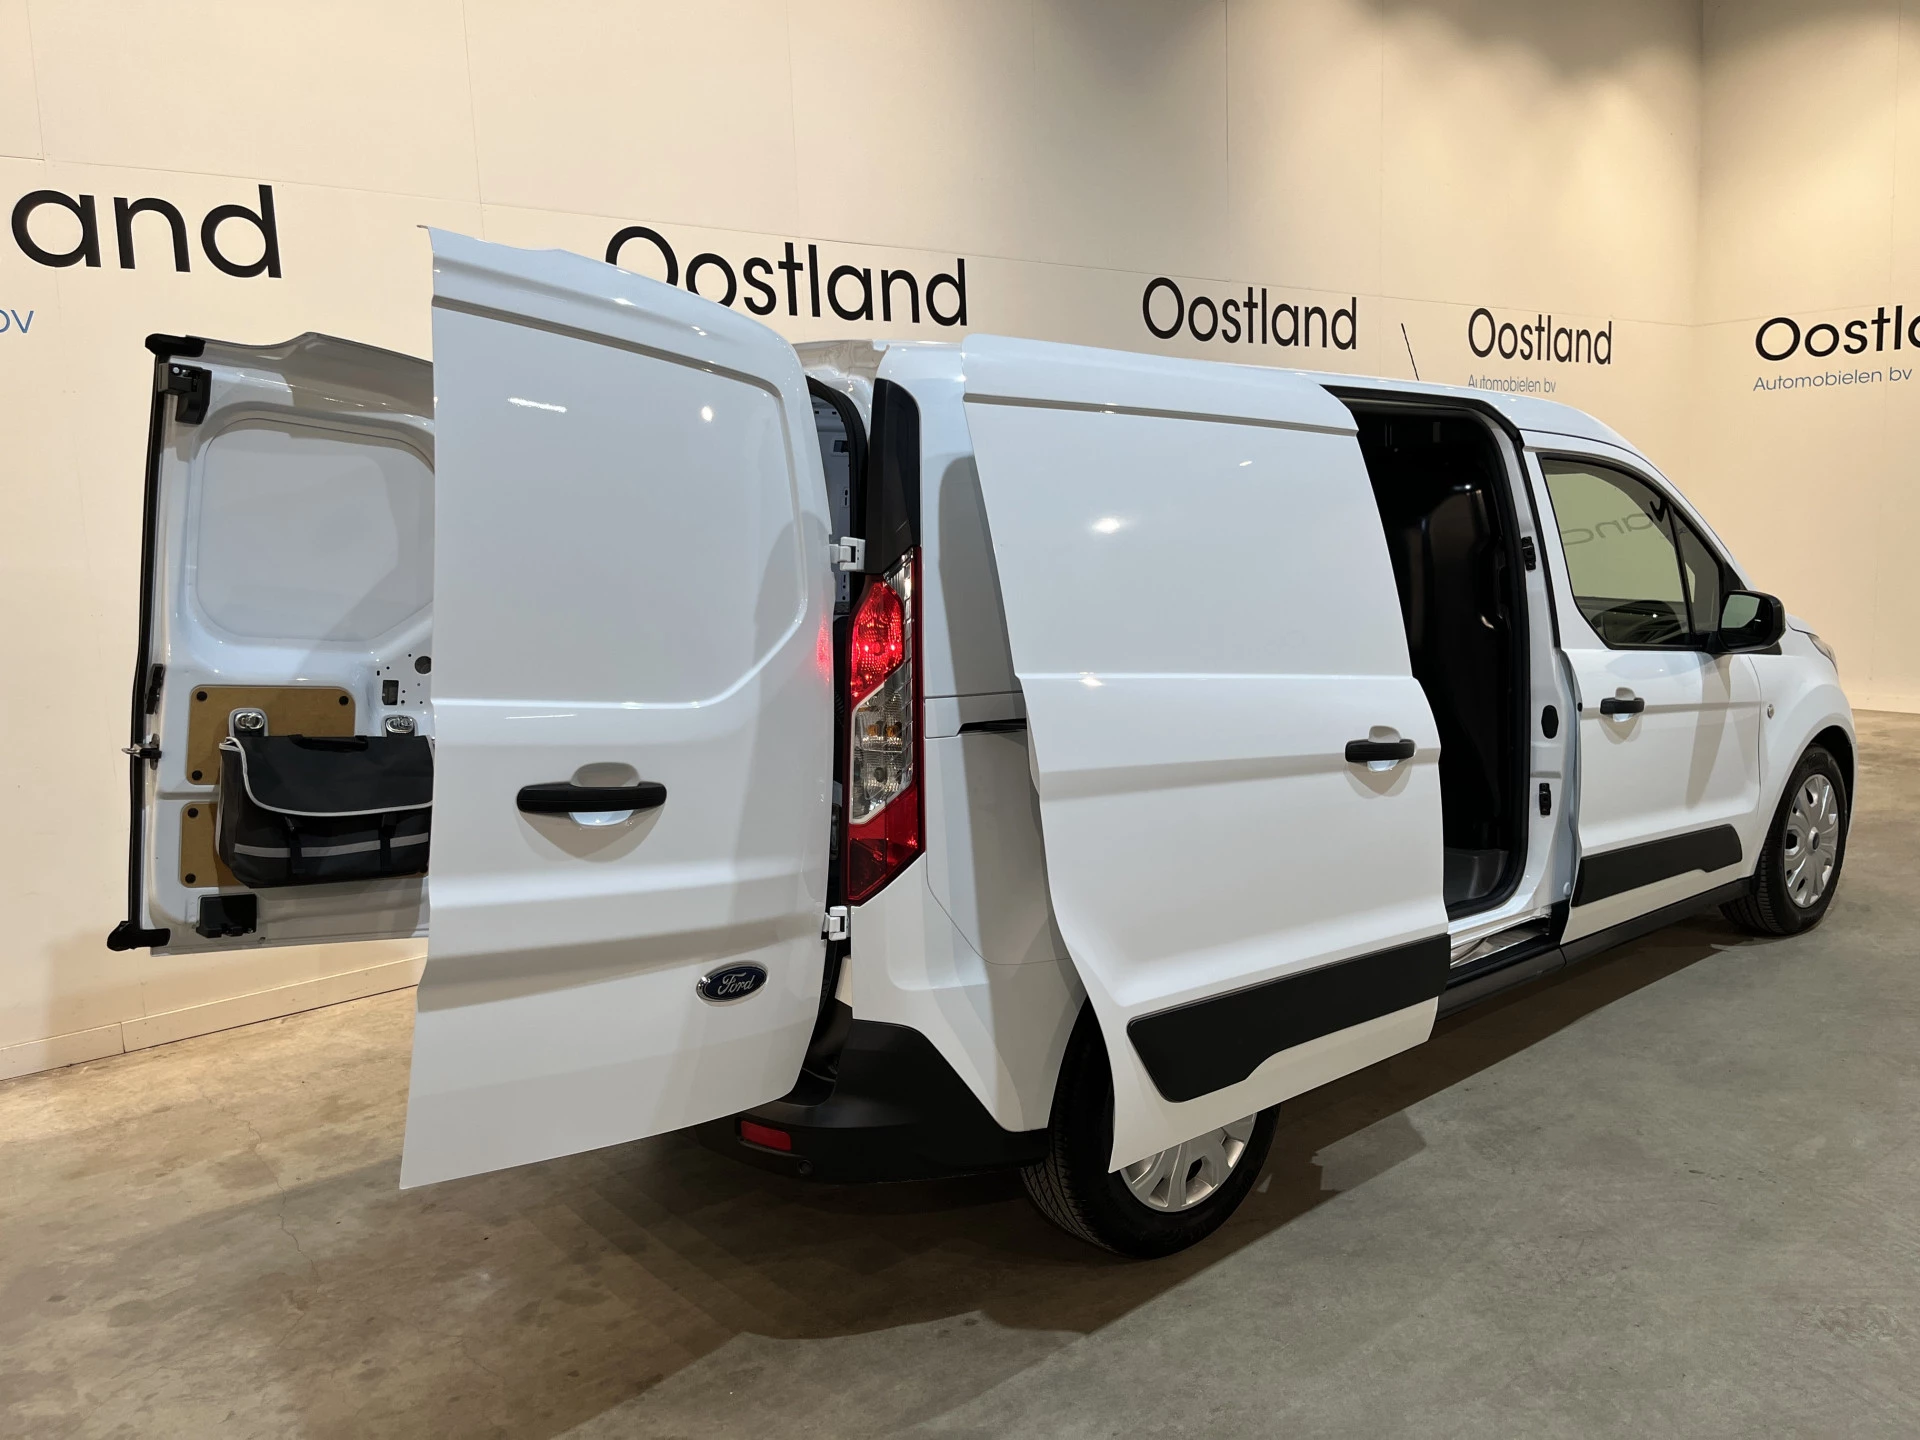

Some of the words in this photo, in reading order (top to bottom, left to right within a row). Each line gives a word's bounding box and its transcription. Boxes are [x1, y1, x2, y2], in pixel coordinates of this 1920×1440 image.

[11, 184, 282, 278] and
[1142, 277, 1357, 350] Oostland
[1468, 308, 1612, 365] Oostland
[1468, 374, 1541, 393] Automobielen
[1543, 377, 1557, 393] bv
[1753, 369, 1882, 391] Automobielen
[1889, 366, 1913, 382] bv
[717, 971, 756, 995] Ford
